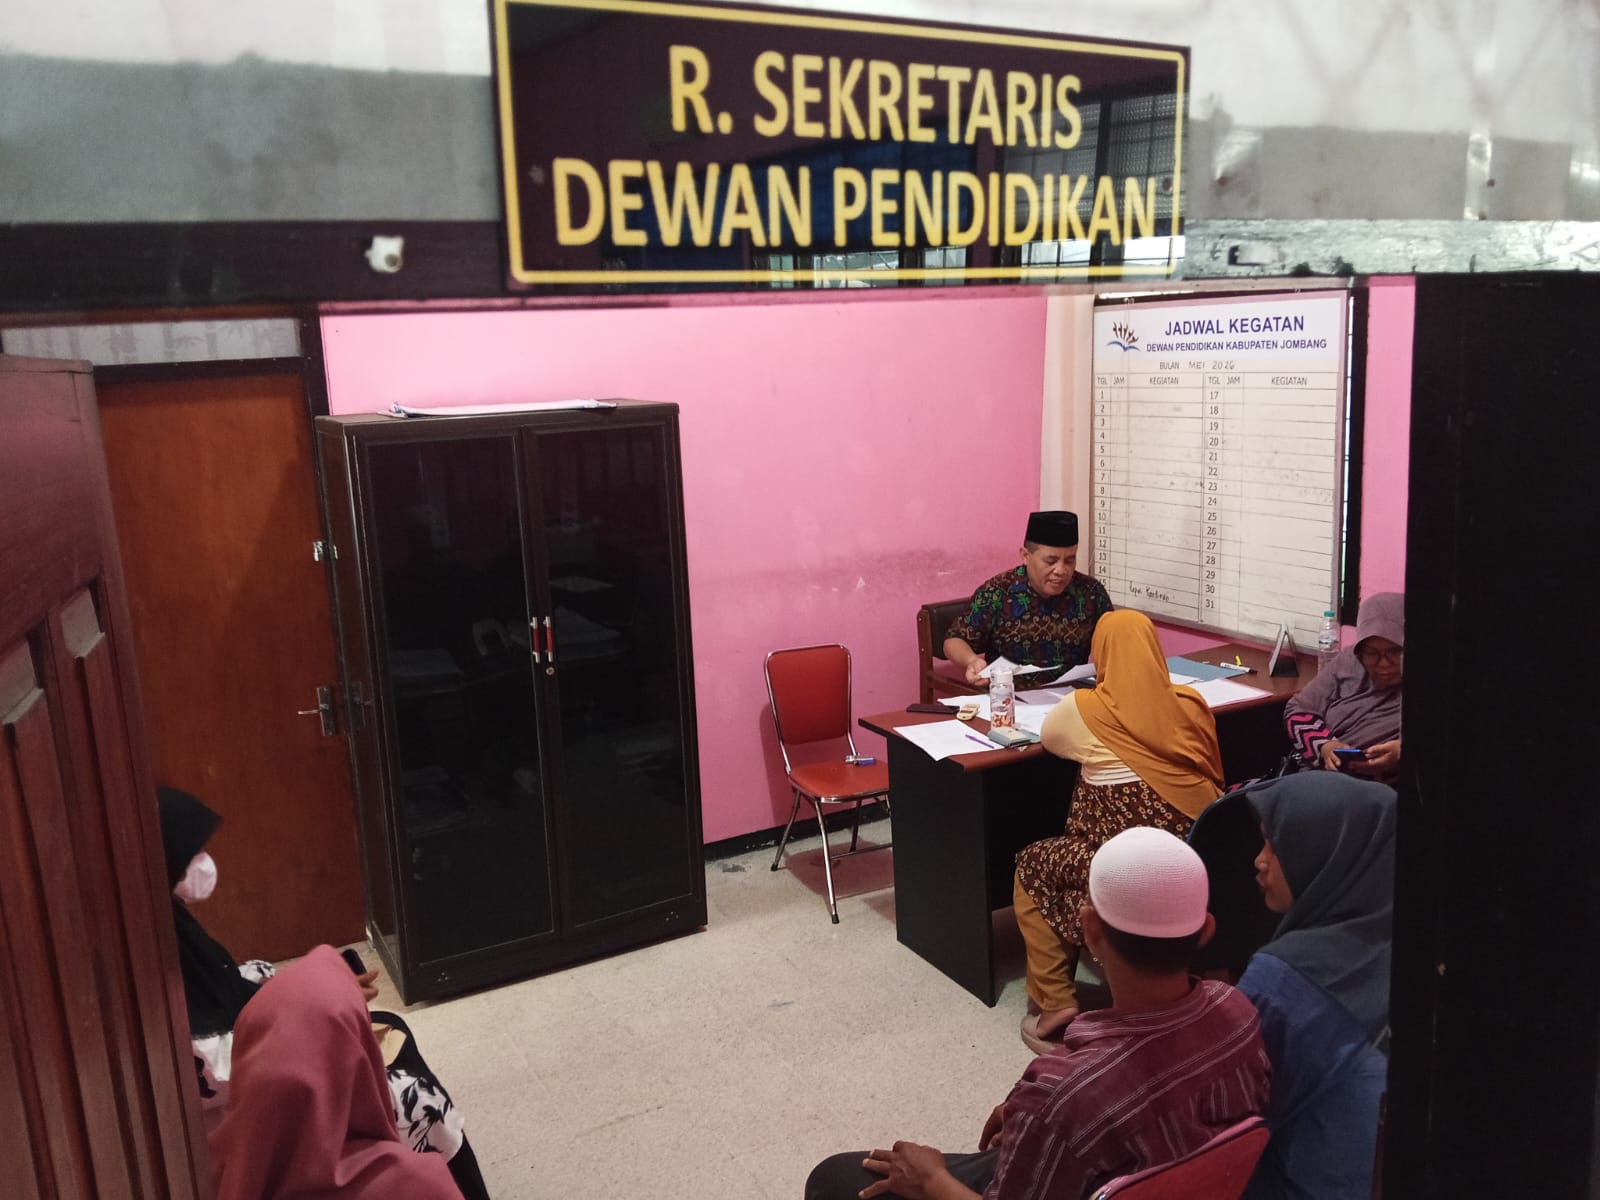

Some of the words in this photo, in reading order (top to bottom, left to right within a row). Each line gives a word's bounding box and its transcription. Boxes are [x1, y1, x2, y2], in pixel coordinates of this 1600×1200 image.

[669, 44, 731, 135] R.
[753, 50, 1082, 151] SEKRETARIS
[552, 157, 811, 247] DEWAN
[834, 166, 1156, 248] PENDIDIKAN
[1165, 319, 1224, 336] JADWAL
[1229, 315, 1304, 334] KEGATAN
[1146, 343, 1174, 352] DEWAN
[1175, 341, 1224, 352] PENDIDIKAN
[1226, 339, 1278, 350] KABUPATEN
[1280, 338, 1327, 350] JOMBANG
[1159, 361, 1180, 370] BULAN
[1188, 360, 1205, 370] MEI
[1211, 360, 1235, 370] 2026
[1097, 376, 1108, 385] TGL
[1113, 376, 1125, 385] JAM
[1149, 376, 1179, 385] KEGIATAN
[1208, 375, 1220, 385] TGL
[1226, 375, 1240, 385] JAM
[1271, 375, 1308, 386] KEGIATAN
[1210, 391, 1219, 400] 17
[1210, 405, 1219, 415] 18
[1210, 421, 1219, 431] 19
[1209, 436, 1219, 446] 20
[1208, 451, 1217, 461] 21
[1208, 466, 1218, 476] 22
[1208, 481, 1218, 491] 23
[1207, 496, 1217, 506] 24
[1098, 512, 1106, 521] 10
[1207, 511, 1217, 521] 25
[1098, 526, 1106, 534] 11
[1207, 526, 1217, 536] 26
[1099, 539, 1106, 548] 12
[1206, 541, 1216, 550] 27
[1099, 552, 1106, 560] 13
[1206, 555, 1216, 565] 28
[1099, 565, 1106, 574] 14
[1205, 570, 1216, 580] 29
[1205, 584, 1215, 594] 30
[1205, 598, 1214, 609] 31
